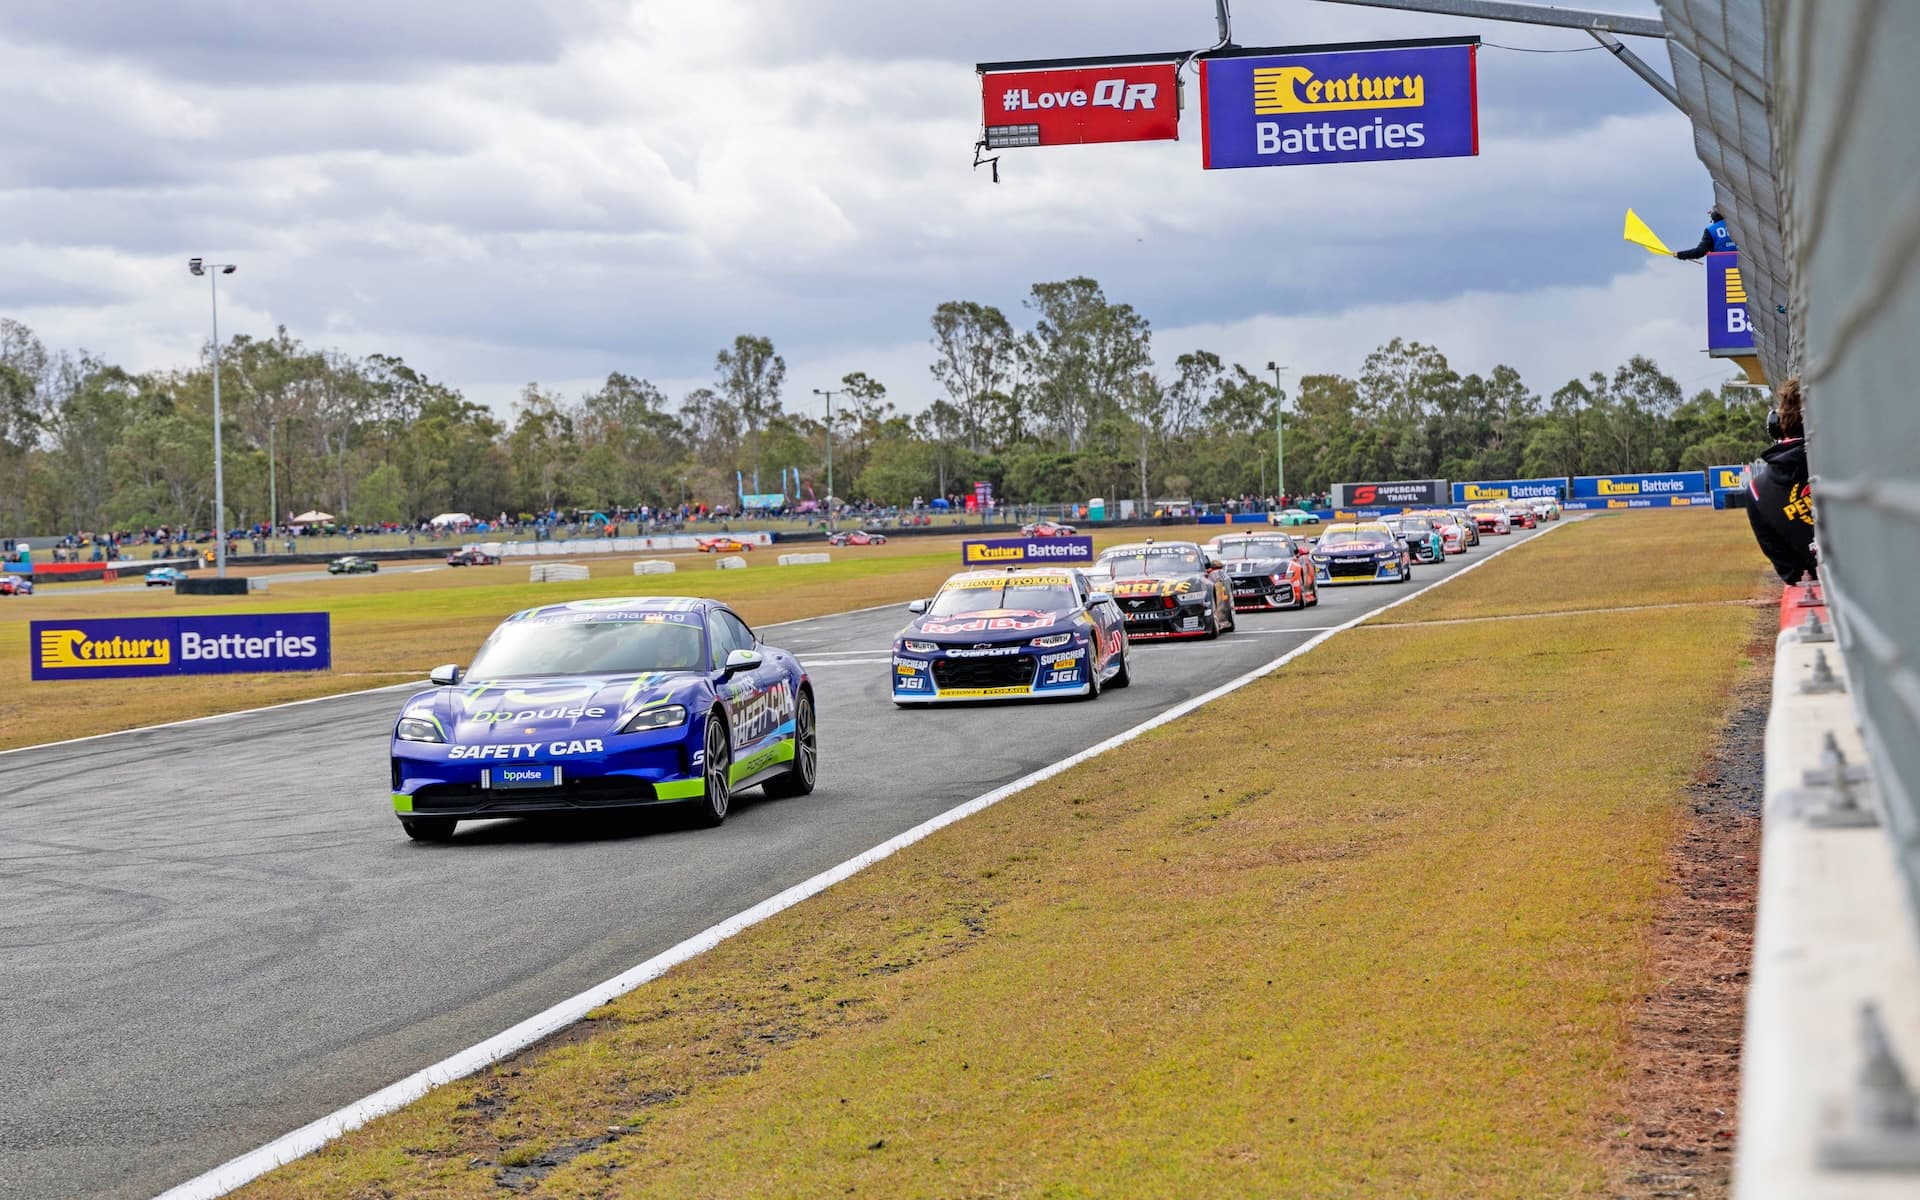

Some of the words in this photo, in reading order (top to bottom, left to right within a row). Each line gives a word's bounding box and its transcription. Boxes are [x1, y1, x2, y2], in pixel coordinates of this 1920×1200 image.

[1003, 88, 1088, 112] #Love
[1092, 78, 1158, 111] QR
[1253, 66, 1425, 115] Century
[1256, 116, 1426, 155] Batteries
[1378, 485, 1427, 495] SUPERCARS
[1511, 484, 1557, 497] Batteries
[1596, 478, 1640, 495] Century
[1641, 480, 1684, 493] Batteries
[1386, 494, 1418, 502] TRAVEL
[967, 543, 1024, 561] Century
[1027, 542, 1088, 557] Batteries
[921, 618, 986, 634] Red
[987, 611, 1056, 631] Bull
[40, 629, 171, 669] Century
[180, 630, 317, 661] Batteries
[1041, 648, 1085, 666] SUPERCHEAP
[448, 743, 542, 759] SAFETY
[549, 738, 604, 756] CAR
